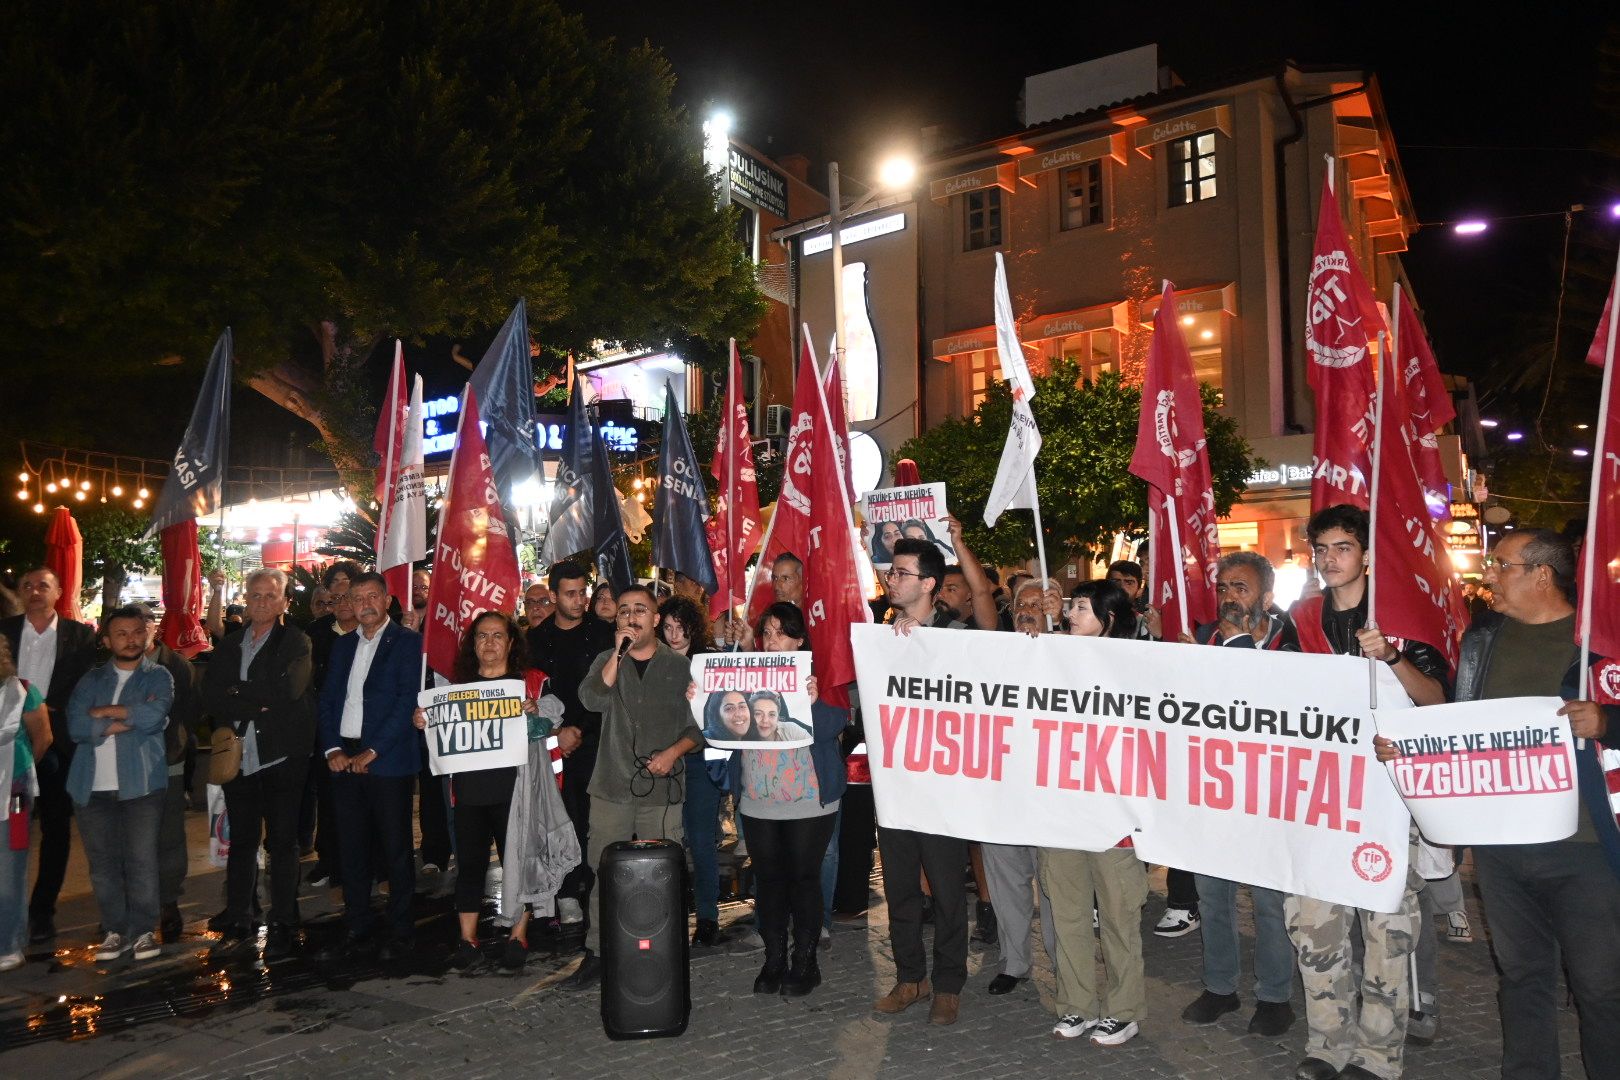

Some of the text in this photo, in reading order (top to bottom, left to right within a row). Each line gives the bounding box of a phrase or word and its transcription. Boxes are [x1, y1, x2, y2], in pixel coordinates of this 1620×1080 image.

[868, 499, 935, 523] ÖZGÜRLÜK!
[705, 655, 742, 668] NEVİN'E
[744, 656, 756, 667] VE
[480, 688, 506, 698] YOKSA
[704, 667, 796, 692] ÖZGÜRLÜK!
[426, 698, 522, 727] SANA HUZUR
[886, 673, 1361, 745] NEHİR VE NEVİN'E ÖZGÜRLÜK!
[437, 718, 501, 754] YOK!
[878, 704, 1014, 782] YUSUF
[1462, 732, 1487, 754] VE
[1489, 725, 1561, 750] NEHİR'E
[1395, 750, 1570, 798] ÖZGÜRLÜK!
[1364, 850, 1382, 864] TİP
